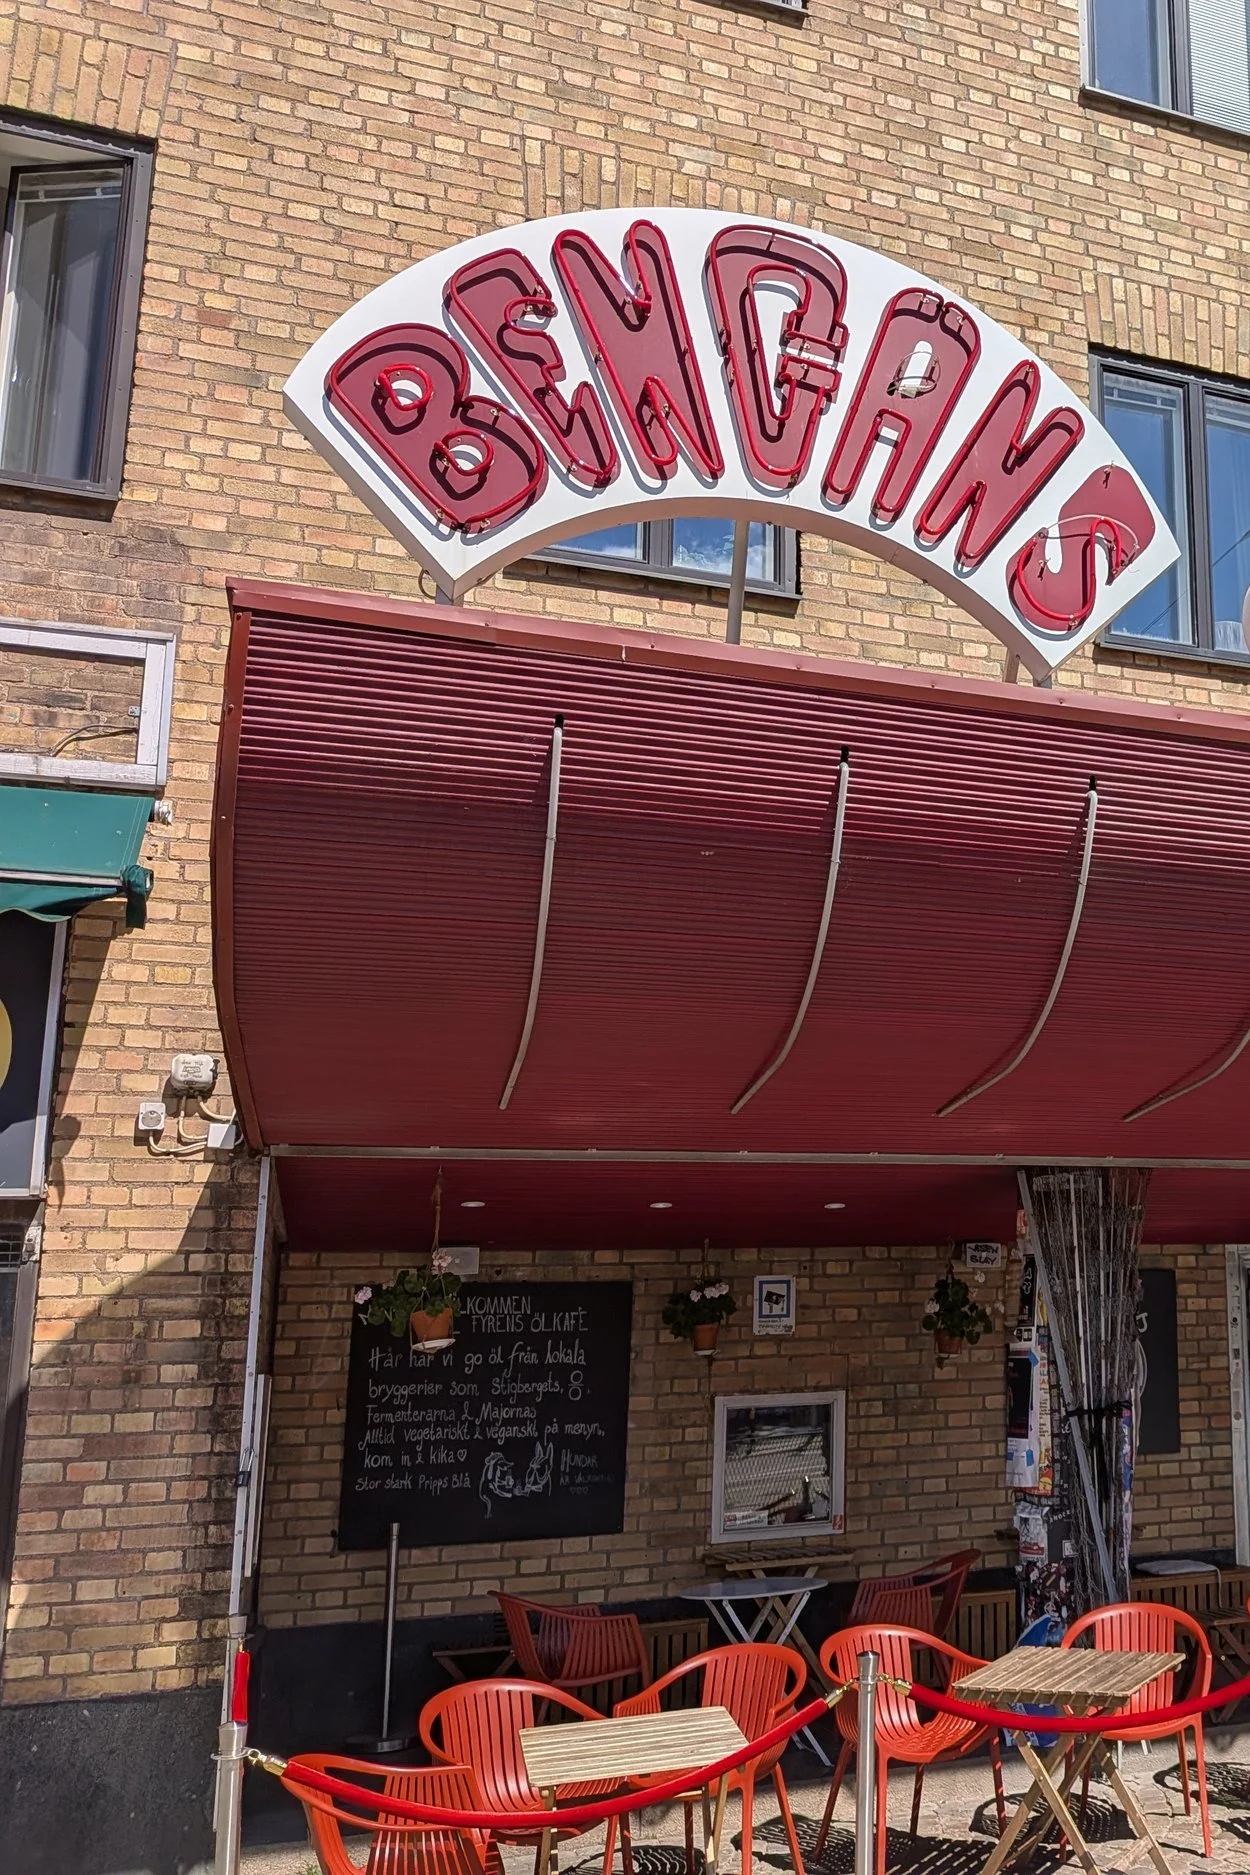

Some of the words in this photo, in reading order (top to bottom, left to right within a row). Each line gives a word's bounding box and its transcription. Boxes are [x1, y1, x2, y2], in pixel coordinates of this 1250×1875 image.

[472, 1314, 524, 1333] FYRENS
[442, 1351, 454, 1366] vi
[464, 1353, 483, 1374] go
[489, 1346, 504, 1364] öl
[545, 1339, 586, 1365] lokala
[369, 1380, 442, 1404] bryggerier
[450, 1381, 479, 1396] som
[366, 1405, 455, 1424] Fermenterarna
[475, 1403, 536, 1425] Majornas
[358, 1426, 395, 1450] Alltid
[404, 1422, 470, 1450] vegetariskt
[486, 1421, 538, 1445] veganskt
[544, 1418, 559, 1445] på
[364, 1449, 392, 1468] kom
[401, 1451, 411, 1466] in
[430, 1446, 455, 1464] kika
[355, 1474, 381, 1492] Stor
[386, 1474, 411, 1489] stark
[419, 1474, 448, 1495] Pripps
[451, 1472, 471, 1489] Blå
